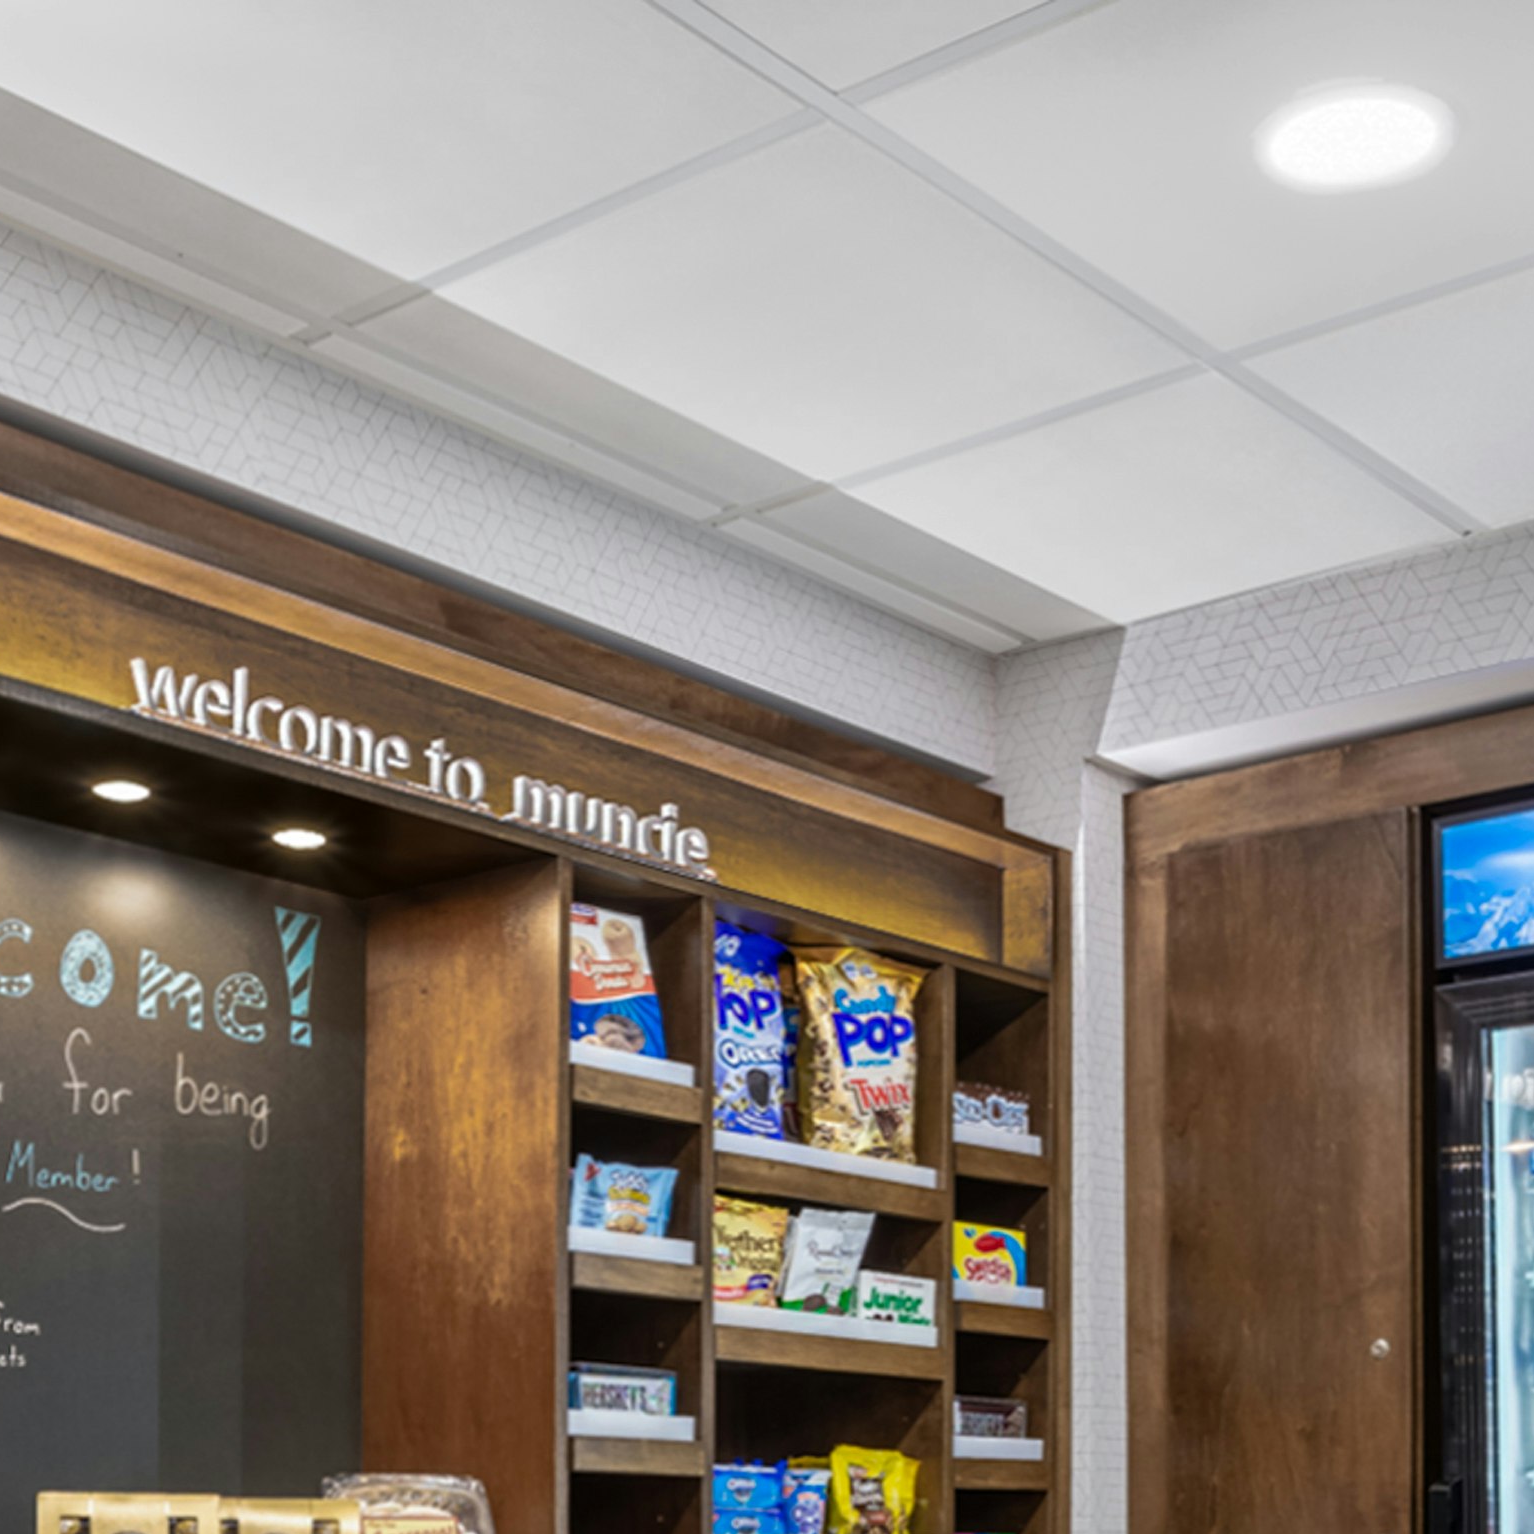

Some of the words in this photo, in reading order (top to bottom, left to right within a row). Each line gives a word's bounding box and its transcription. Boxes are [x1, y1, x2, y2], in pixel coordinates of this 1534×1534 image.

[129, 657, 411, 779] welcome
[422, 738, 487, 803] to
[512, 774, 710, 870] muncie
[832, 1012, 914, 1068] POP
[63, 1027, 133, 1116] for
[175, 1052, 272, 1151] being
[863, 1286, 925, 1313] Junior
